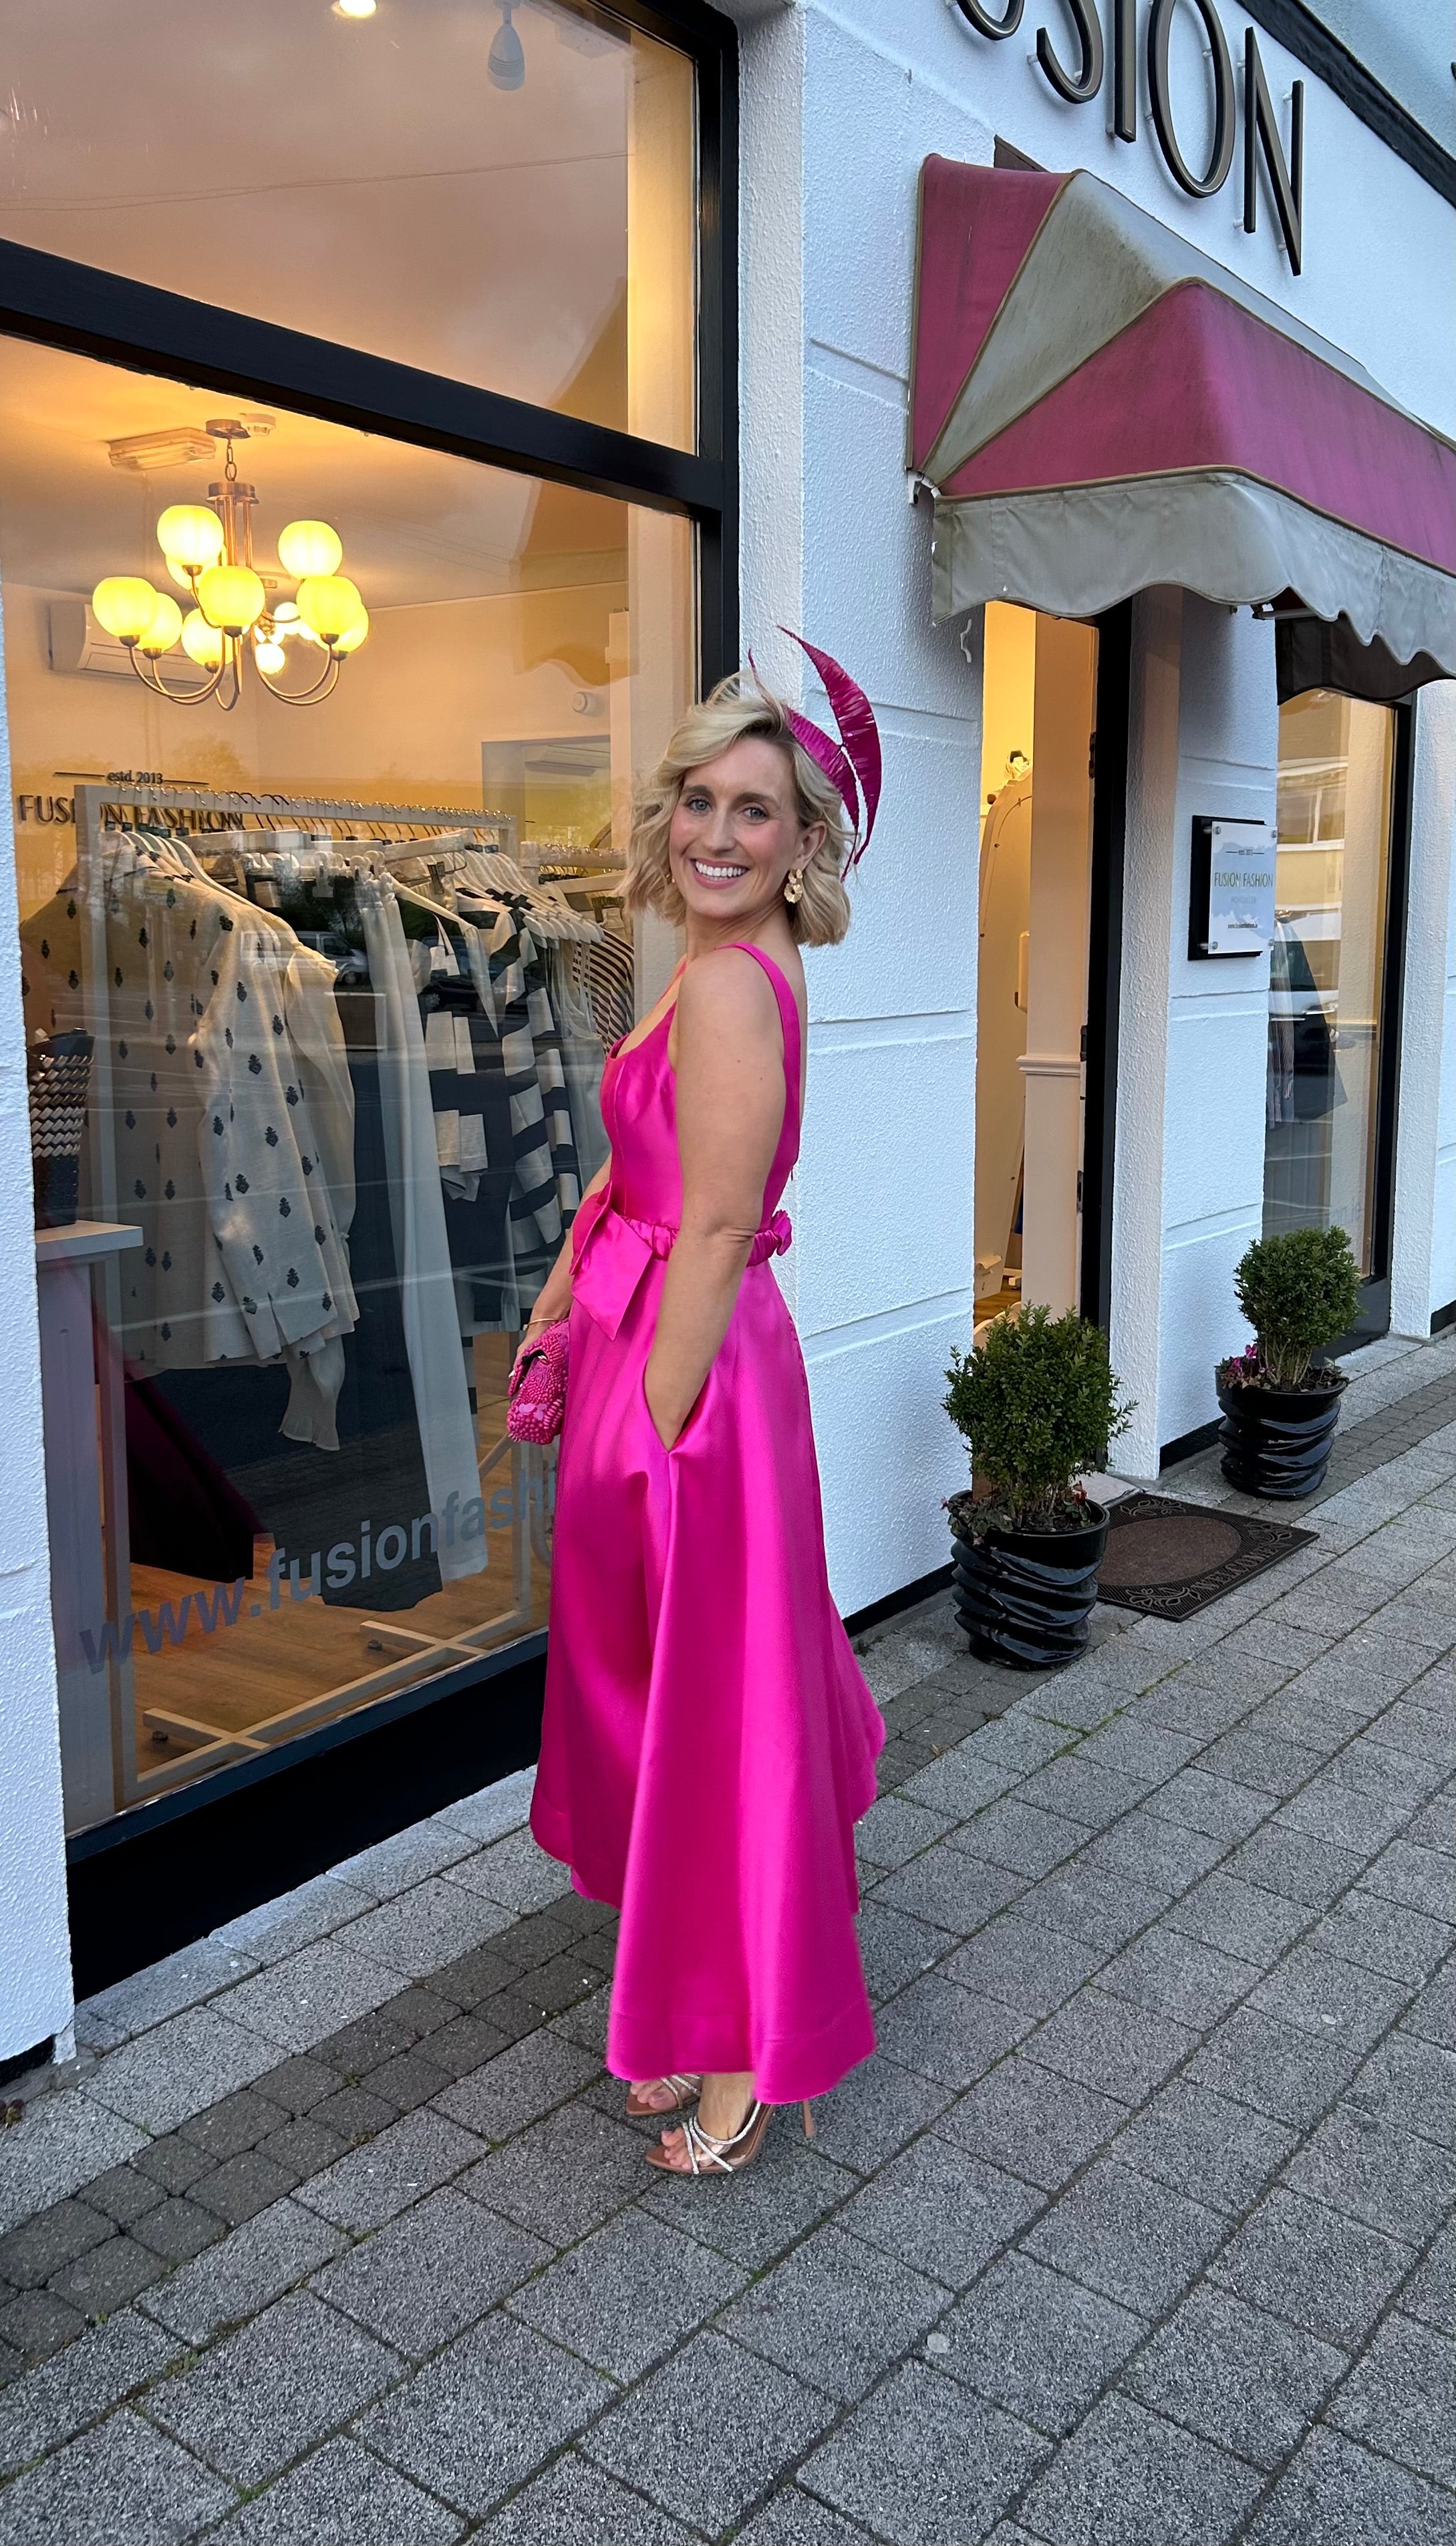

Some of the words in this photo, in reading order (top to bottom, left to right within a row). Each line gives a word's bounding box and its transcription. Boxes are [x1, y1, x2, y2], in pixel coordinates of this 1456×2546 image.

[956, 0, 1304, 275] ION
[136, 771, 164, 784] 2013
[19, 795, 123, 825] FUSIN
[1214, 872, 1241, 888] FUSION
[1243, 872, 1274, 888] FASHION
